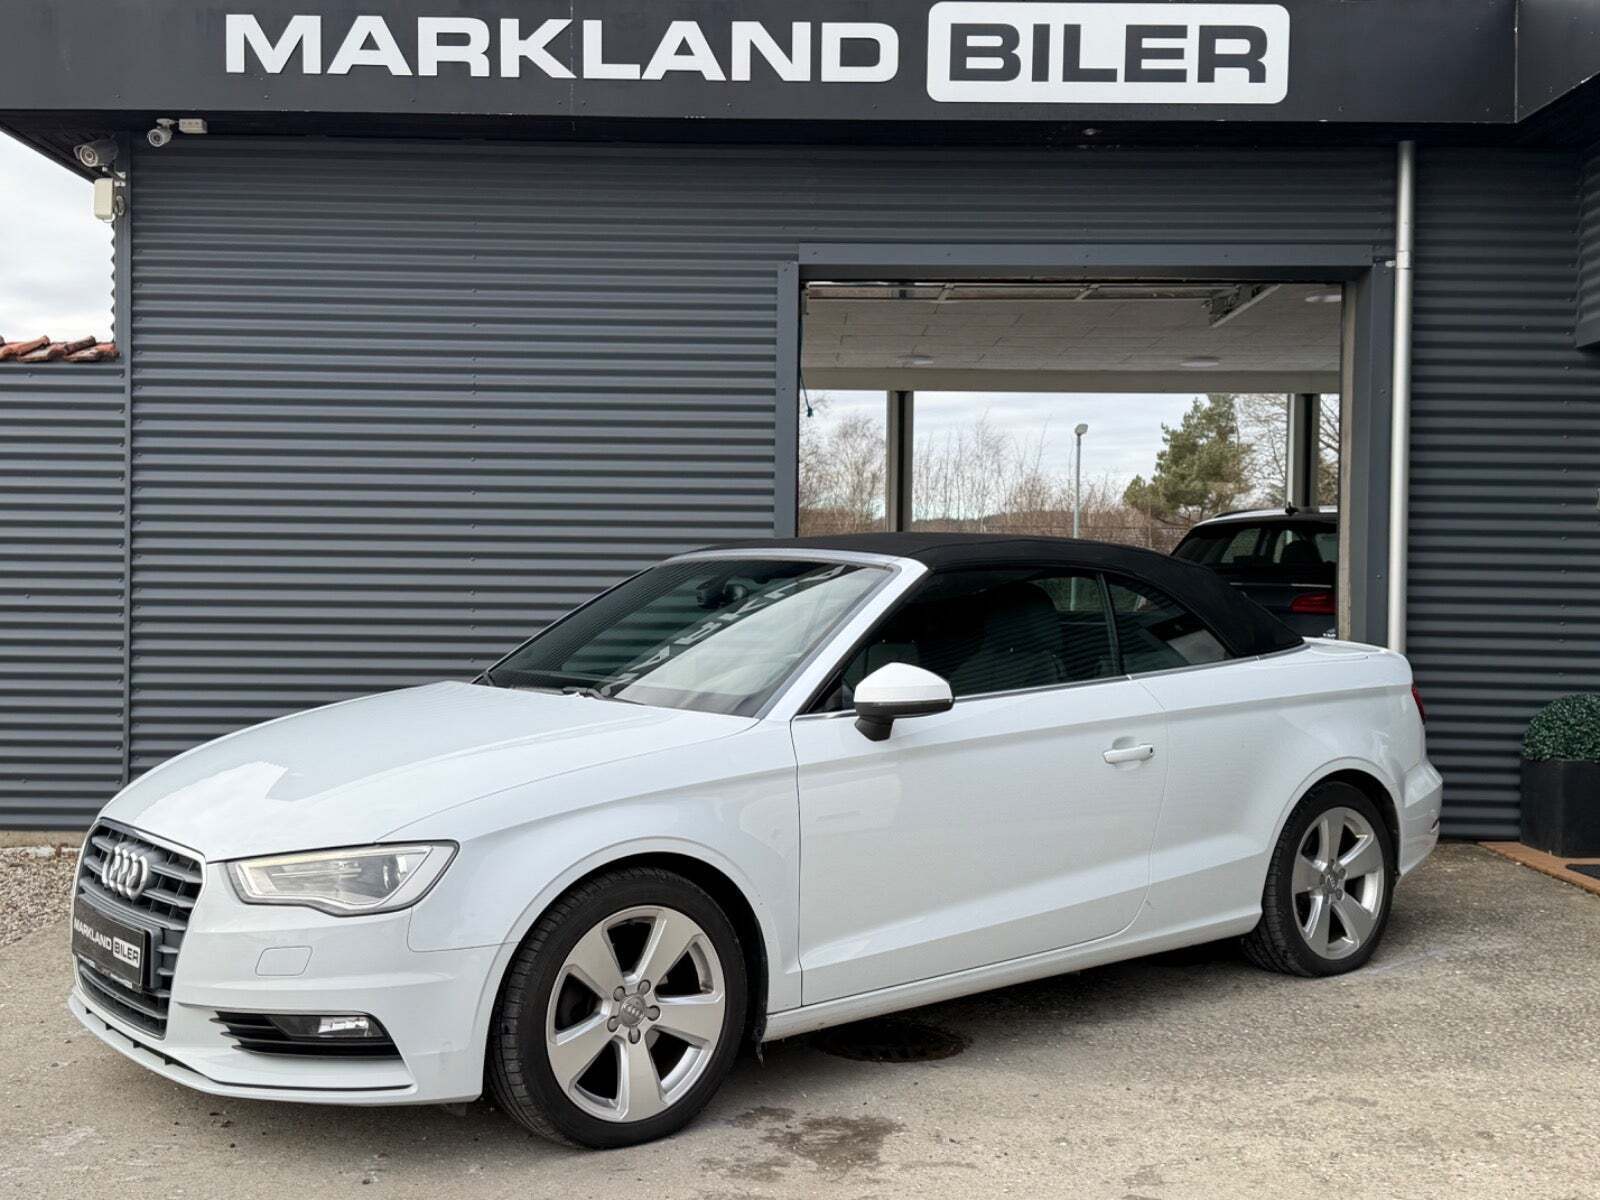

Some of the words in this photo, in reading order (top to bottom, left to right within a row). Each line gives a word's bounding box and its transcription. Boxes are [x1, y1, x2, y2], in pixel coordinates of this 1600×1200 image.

[225, 14, 899, 83] MARKLAND
[949, 23, 1268, 84] BILER
[74, 916, 112, 951] MARKLAND
[114, 940, 139, 965] BILER
